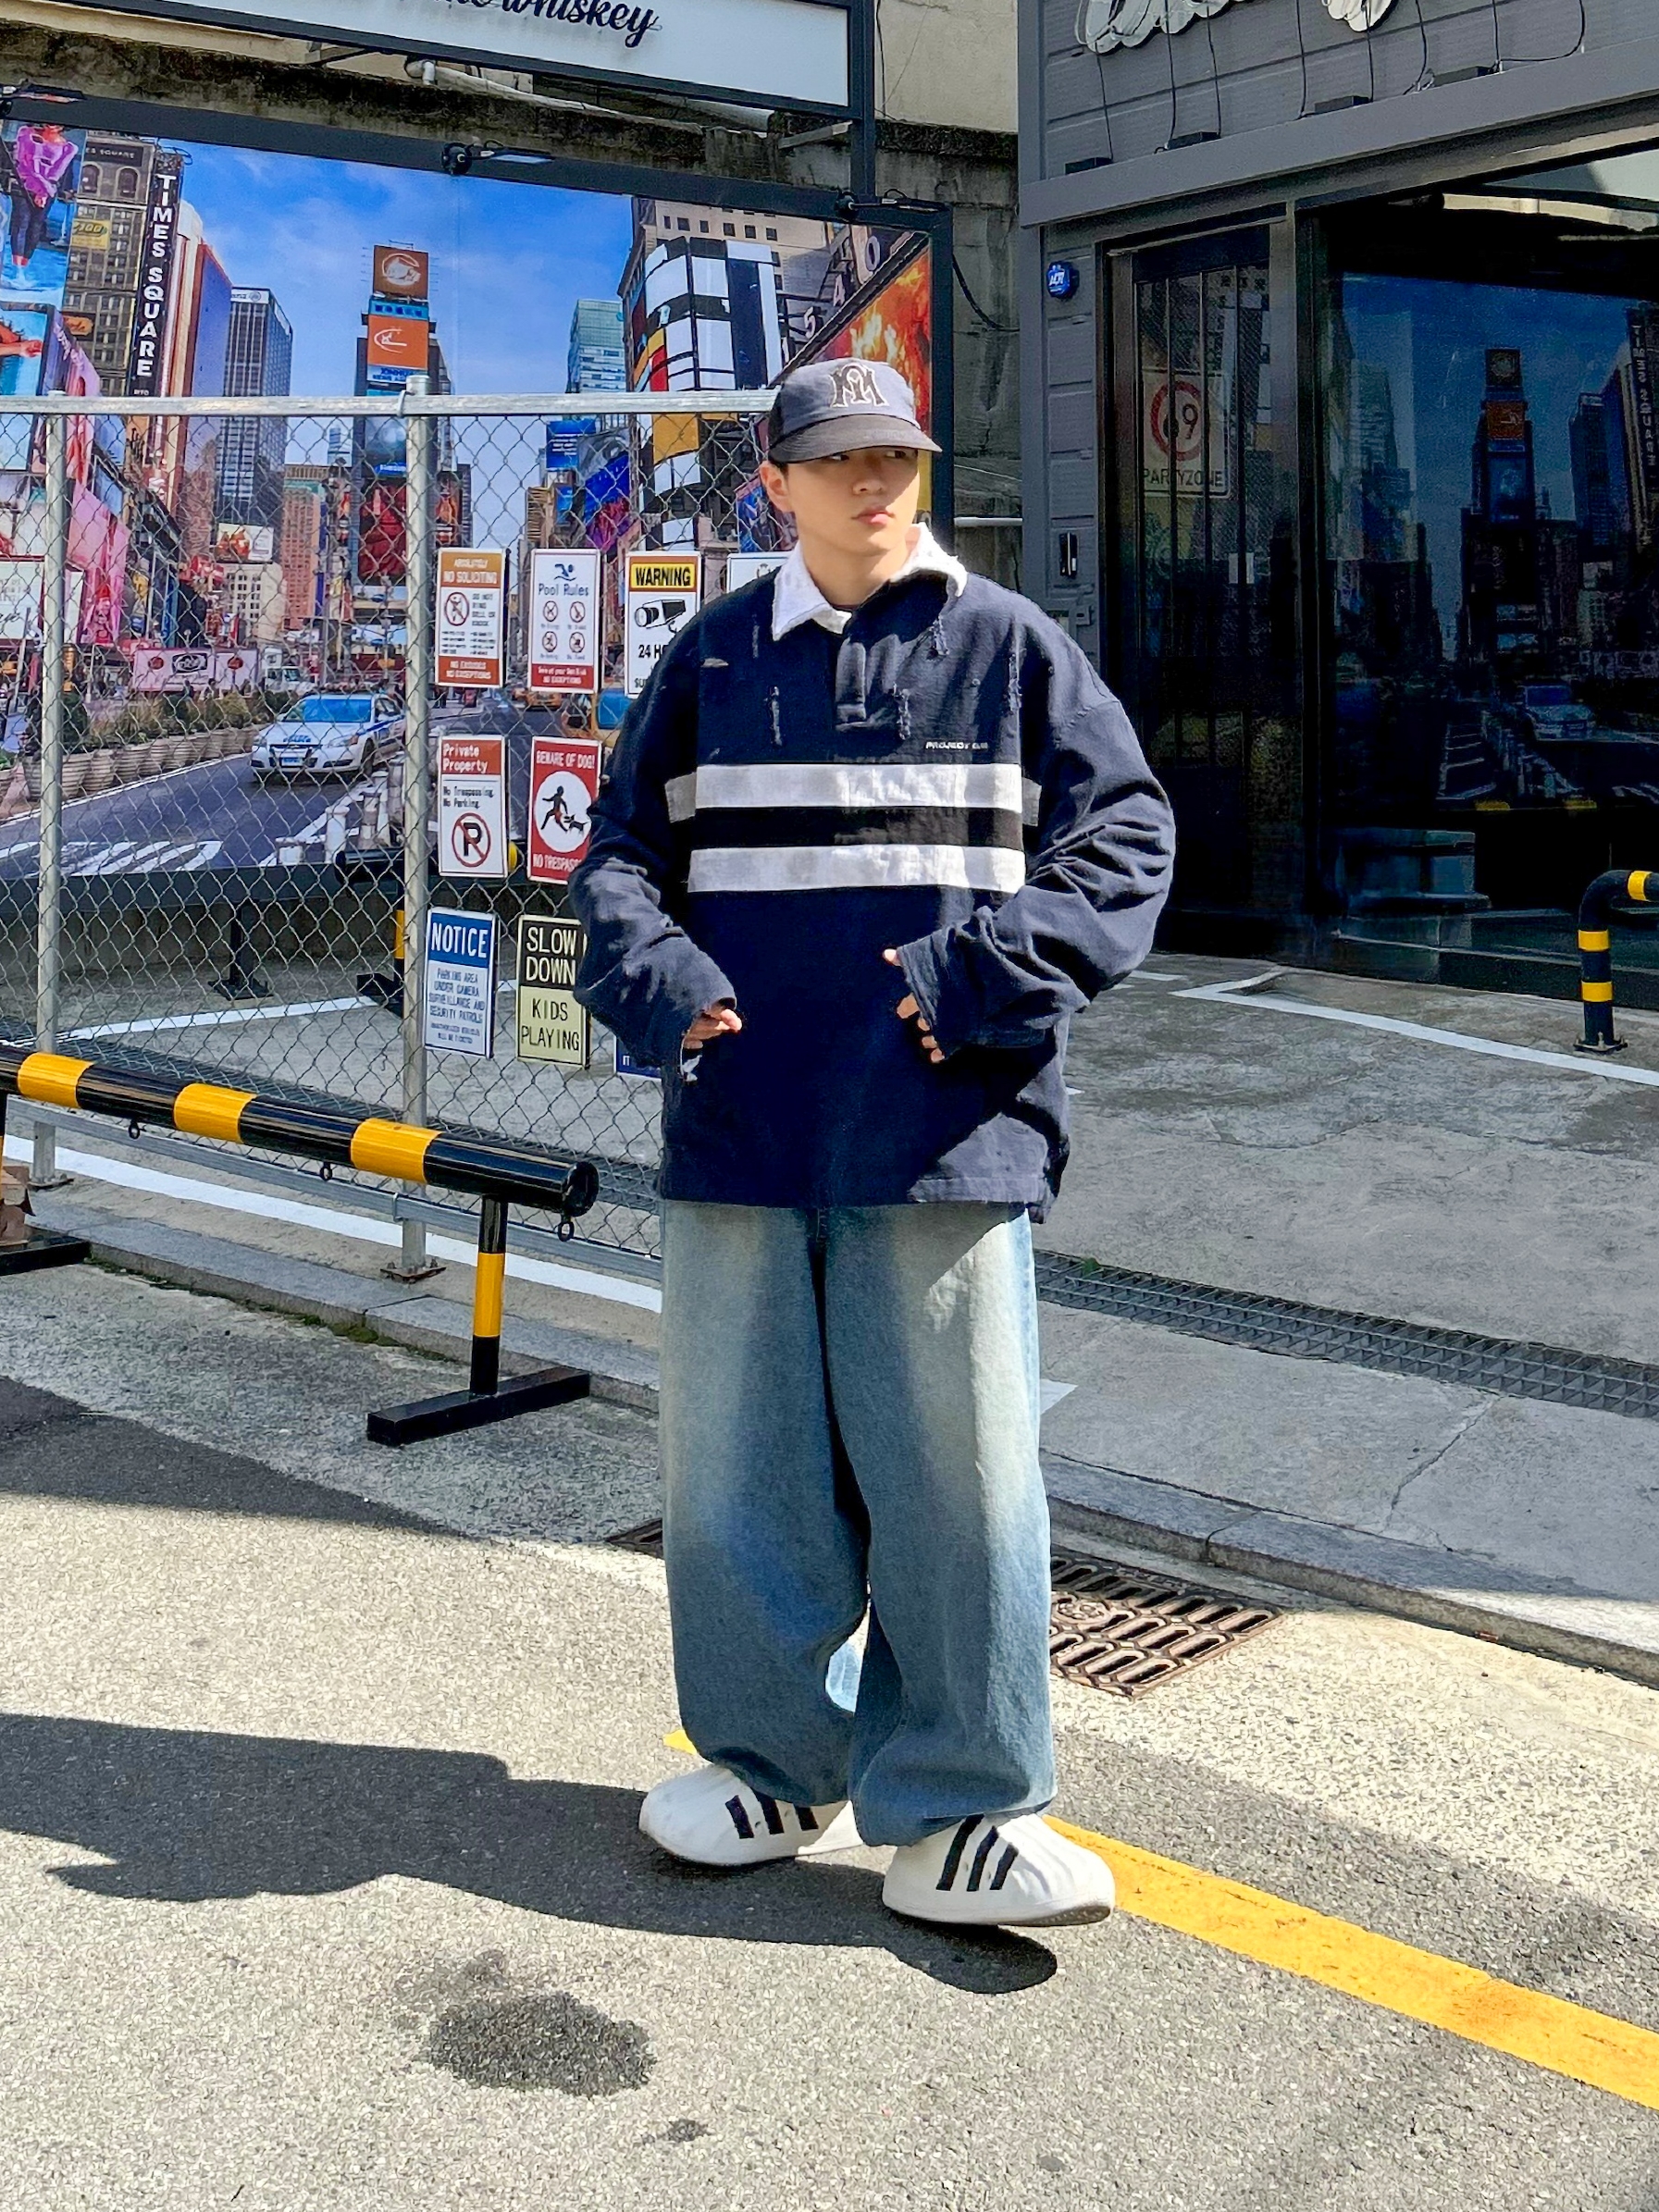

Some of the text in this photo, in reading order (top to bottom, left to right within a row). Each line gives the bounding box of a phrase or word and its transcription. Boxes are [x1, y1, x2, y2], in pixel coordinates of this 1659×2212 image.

[152, 174, 177, 258] TIMES
[136, 267, 164, 377] SQUARE
[1144, 468, 1224, 488] PARYZOE
[636, 567, 691, 587] WARNING
[539, 583, 589, 597] Pool Rules
[638, 644, 651, 659] 24
[443, 743, 479, 758] Private
[536, 750, 595, 769] BEWARE OF DOG!
[443, 758, 489, 774] Property
[532, 854, 543, 868] NO
[431, 922, 489, 958] NOTICE
[526, 927, 576, 957] SLOW
[464, 971, 477, 983] AREA
[526, 957, 576, 986] DOWN
[532, 997, 569, 1021] KIDS
[521, 1025, 580, 1051] PLAYING
